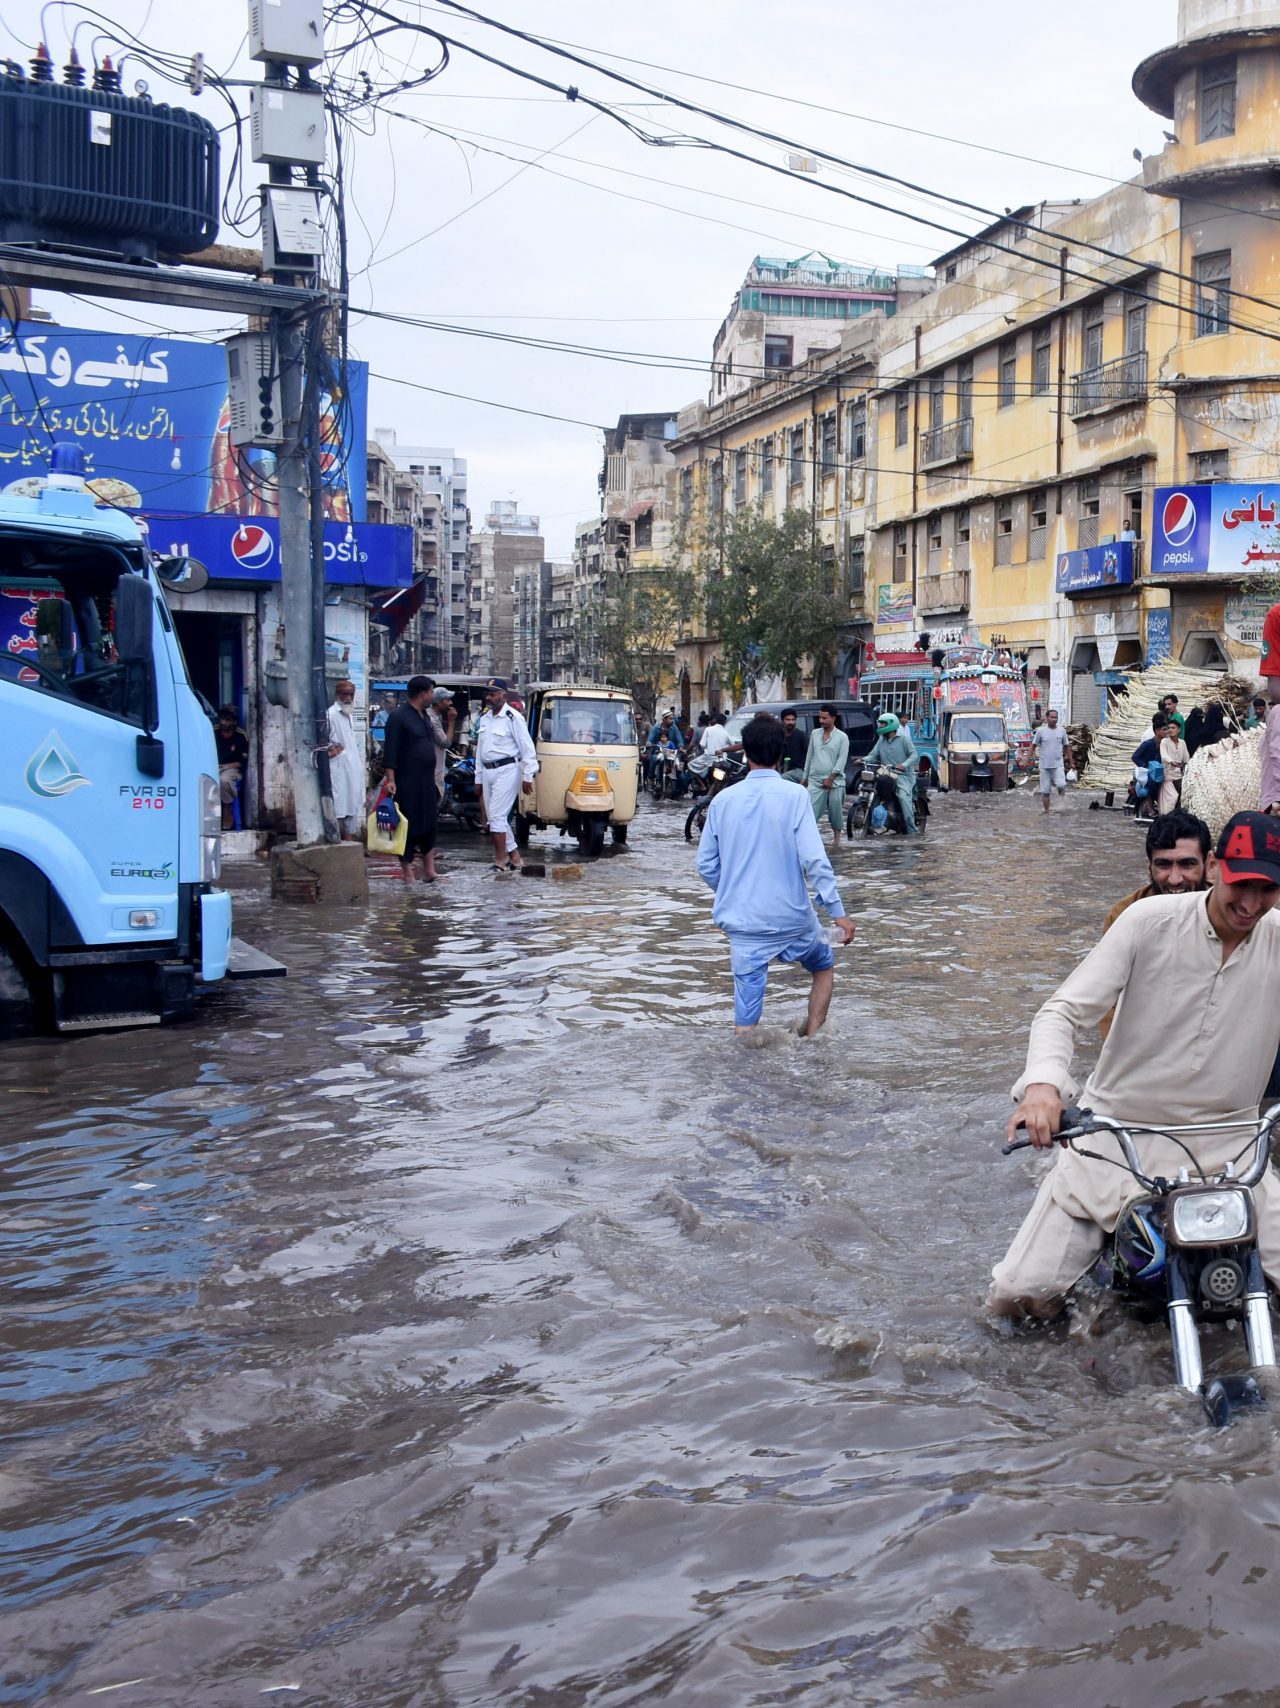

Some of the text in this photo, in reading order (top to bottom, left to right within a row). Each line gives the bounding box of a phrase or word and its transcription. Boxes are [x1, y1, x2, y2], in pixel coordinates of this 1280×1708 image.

[279, 539, 358, 564] psi
[1163, 550, 1191, 567] pepsi
[1241, 632, 1258, 640] EXCEL
[119, 785, 177, 797] FVR 90
[132, 798, 164, 809] 210
